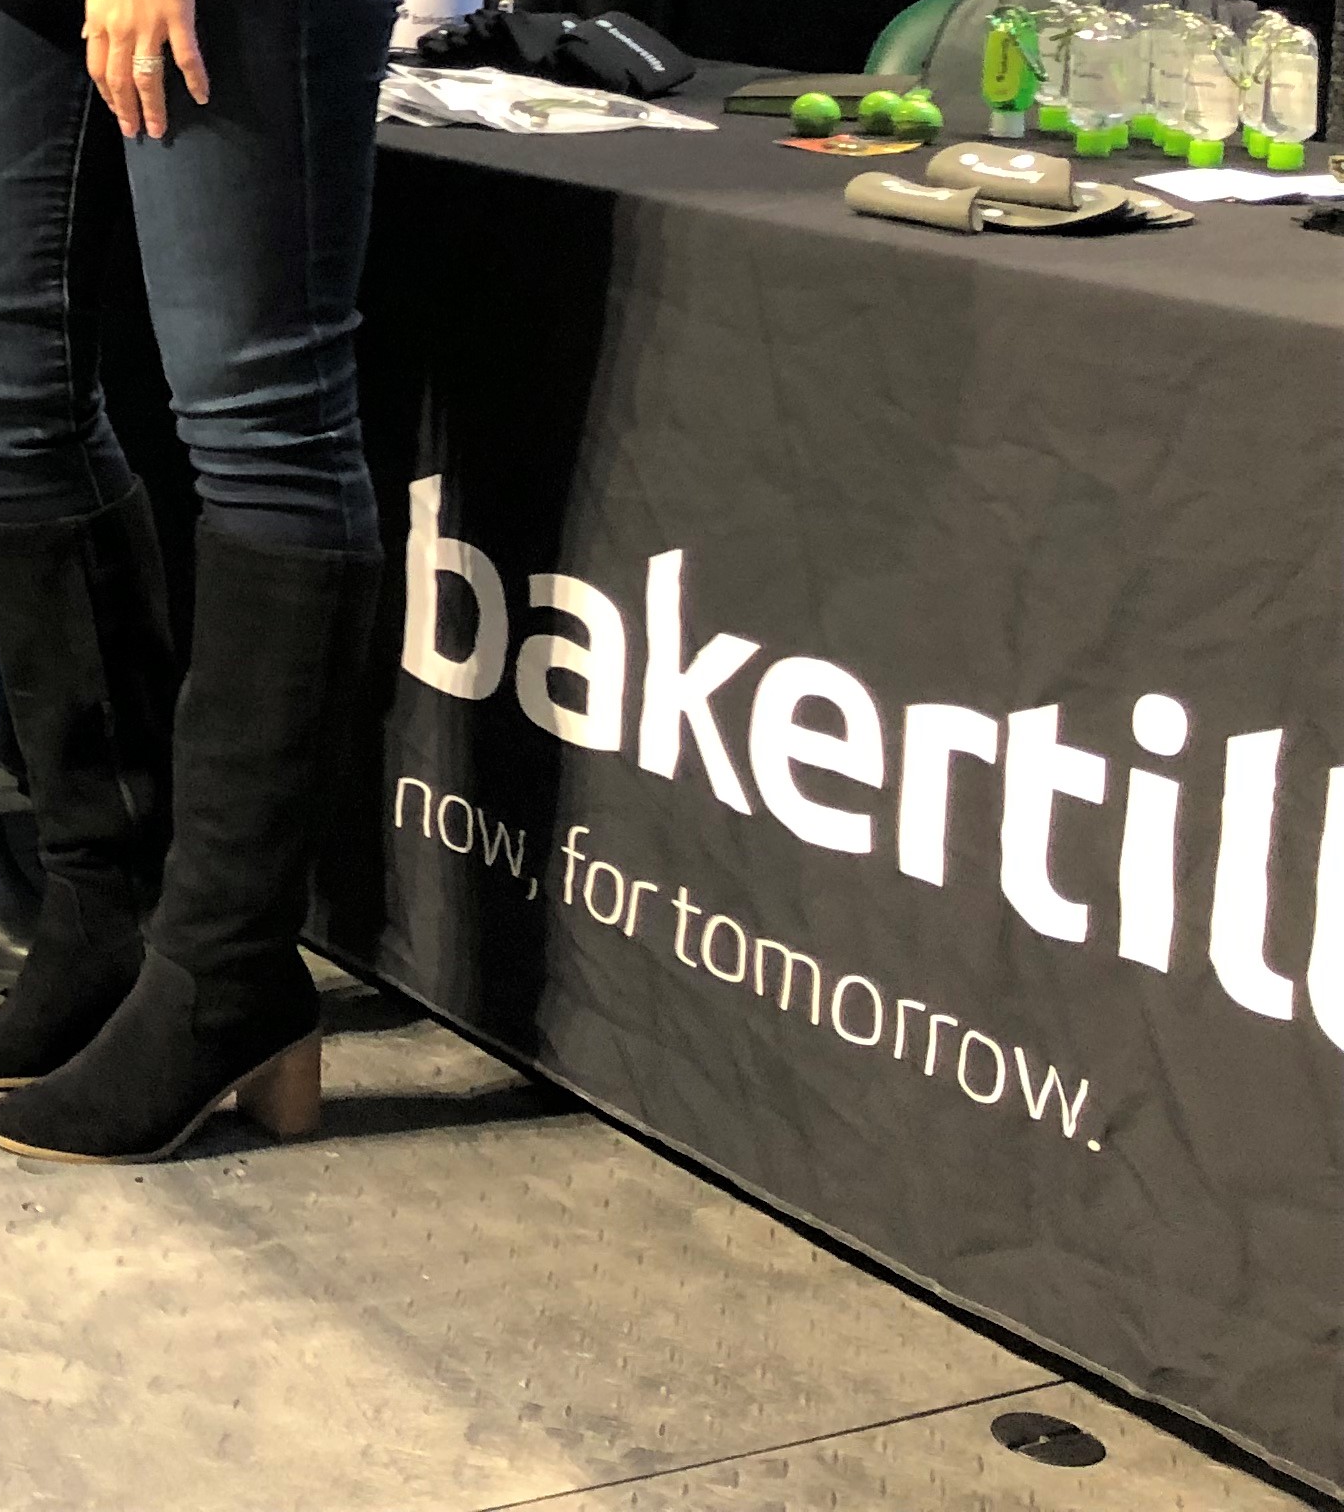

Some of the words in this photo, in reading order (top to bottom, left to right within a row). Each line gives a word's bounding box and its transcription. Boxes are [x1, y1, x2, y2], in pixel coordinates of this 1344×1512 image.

[394, 776, 538, 900] now,
[561, 825, 658, 938] for
[673, 886, 1103, 1154] tomorrow.
